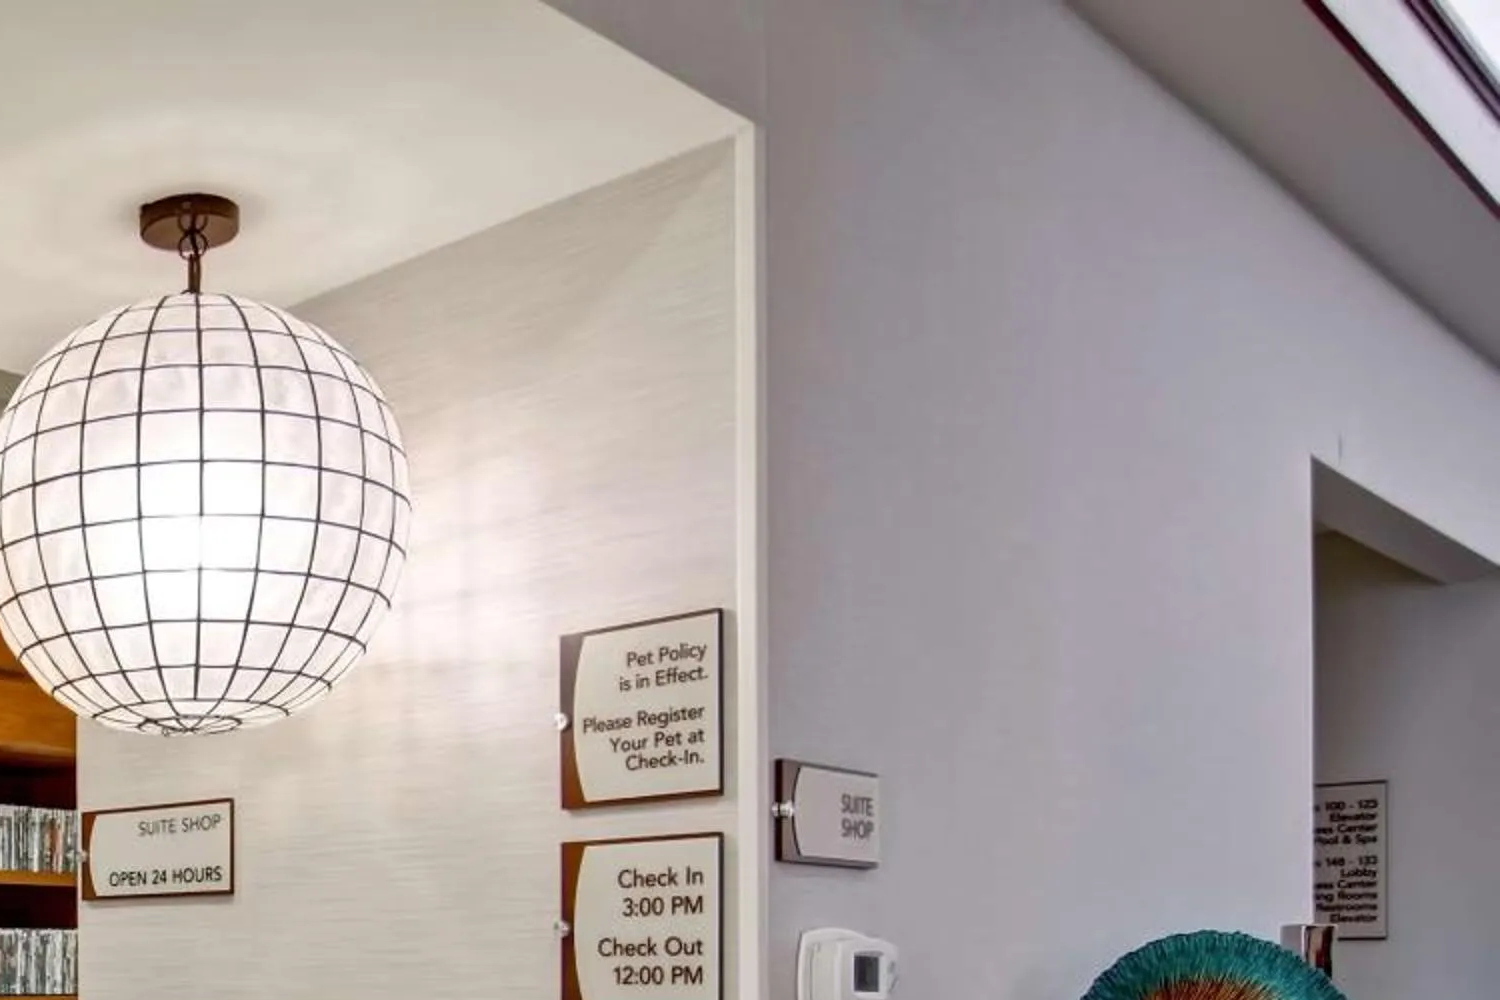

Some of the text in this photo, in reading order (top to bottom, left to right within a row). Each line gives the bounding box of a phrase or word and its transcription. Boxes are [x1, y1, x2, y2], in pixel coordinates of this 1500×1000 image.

[626, 642, 708, 667] Pet Policy
[619, 666, 709, 691] is in Effect.
[583, 706, 706, 734] Please Register
[610, 729, 705, 753] Your Pet at
[625, 750, 705, 771] Check-In.
[841, 793, 875, 817] SUITE
[138, 813, 222, 836] SUITE SHOP
[1329, 812, 1377, 823] Elevator
[1337, 823, 1377, 833] Center
[841, 817, 874, 841] SHOP
[109, 865, 223, 887] OPEN 24 HOURS
[617, 865, 704, 888] Check In
[1337, 879, 1377, 889] Center
[1340, 868, 1377, 879] Lobby
[622, 895, 704, 917] 3:00 PM
[1329, 913, 1377, 923] Elevator
[597, 936, 704, 957] Check Out
[613, 965, 704, 985] 12:00 PM
